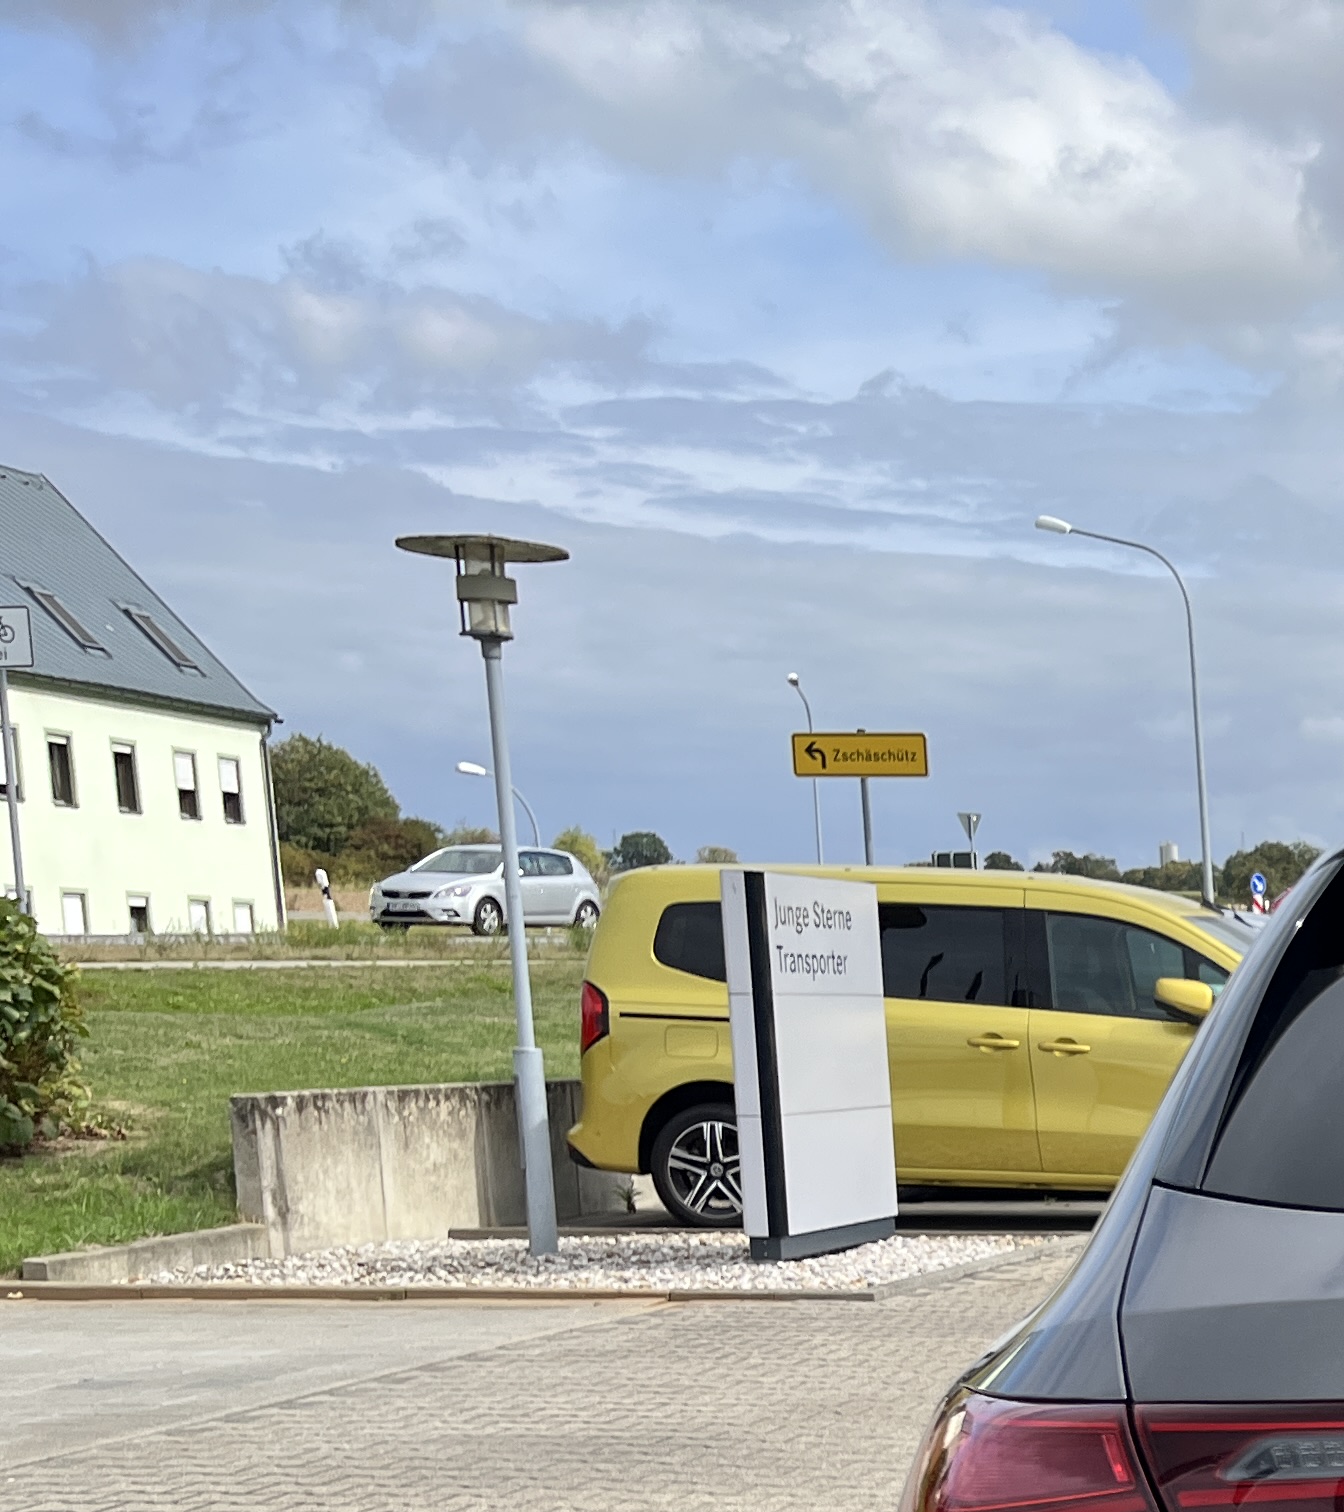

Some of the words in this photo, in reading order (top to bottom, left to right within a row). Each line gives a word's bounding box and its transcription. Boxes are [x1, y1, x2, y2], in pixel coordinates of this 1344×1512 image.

[832, 748, 918, 764] Zschäschütz
[774, 896, 810, 934] Junge
[813, 900, 852, 931] Sterne
[776, 945, 848, 981] Transporter
